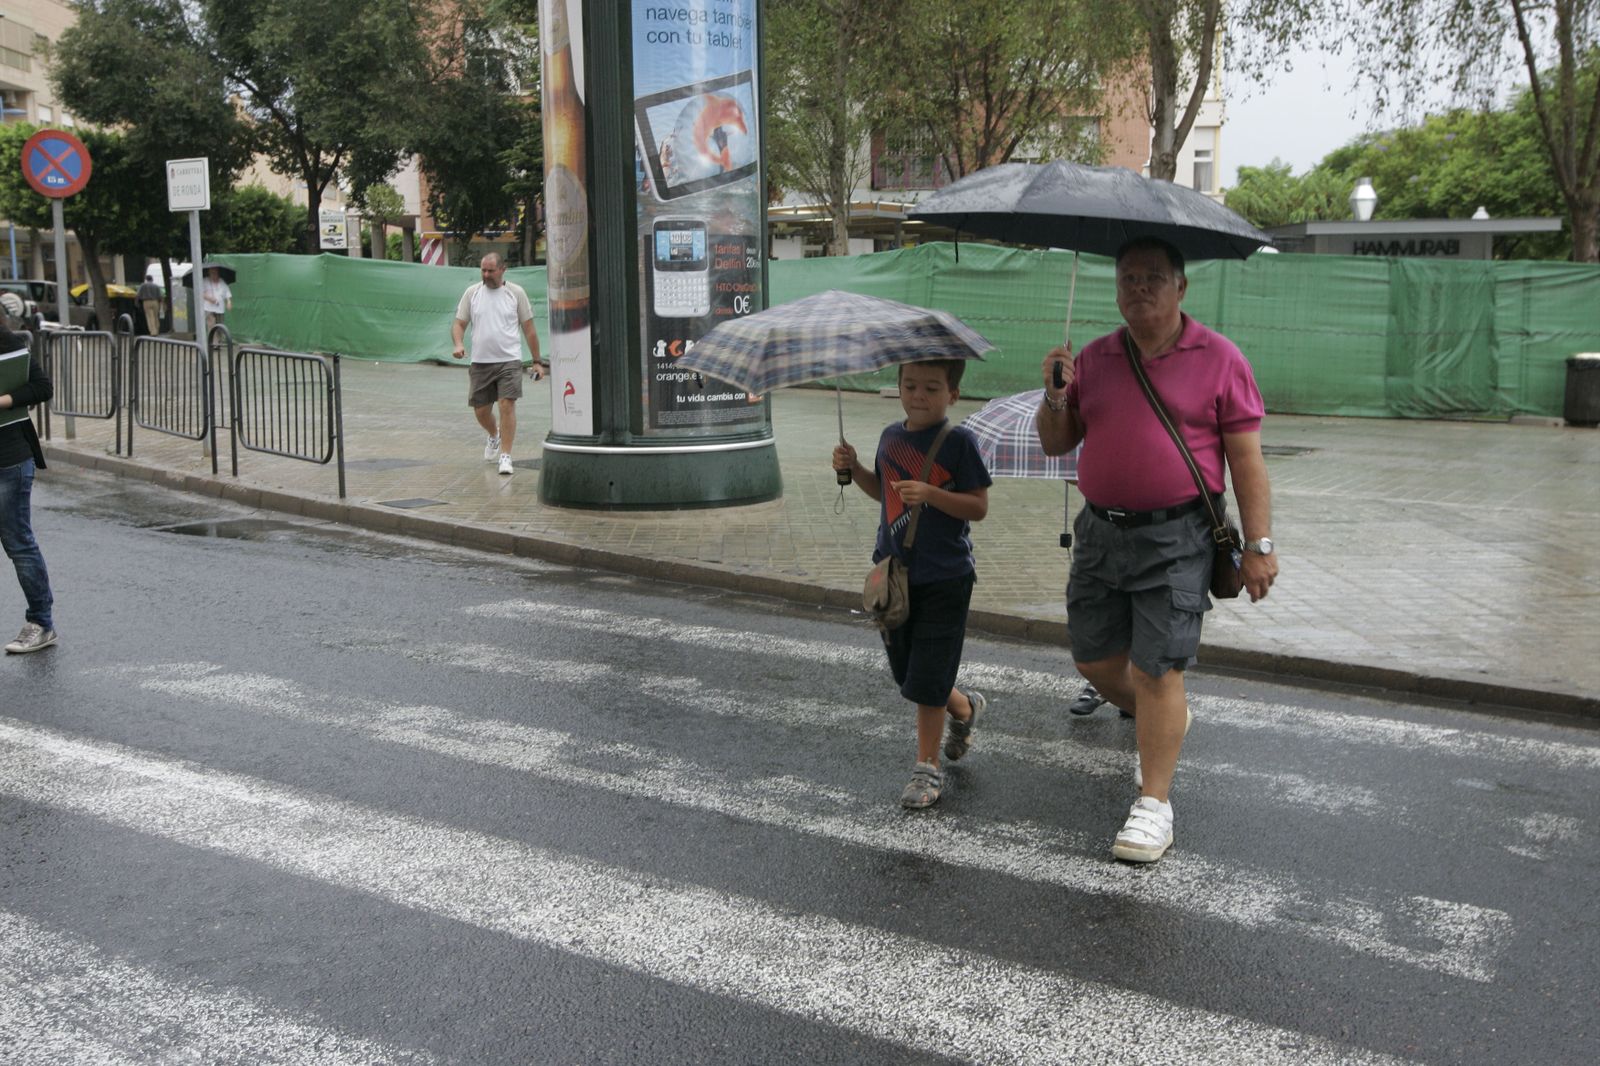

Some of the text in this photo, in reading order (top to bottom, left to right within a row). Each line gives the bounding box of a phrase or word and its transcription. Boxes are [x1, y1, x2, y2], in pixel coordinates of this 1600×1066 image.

[646, 7, 708, 25] navega
[646, 29, 742, 50] con tu tablet
[1353, 239, 1460, 256] HAMMURABI
[676, 394, 686, 403] tu
[687, 393, 706, 402] vida
[706, 392, 734, 402] cambia
[734, 392, 746, 401] con
